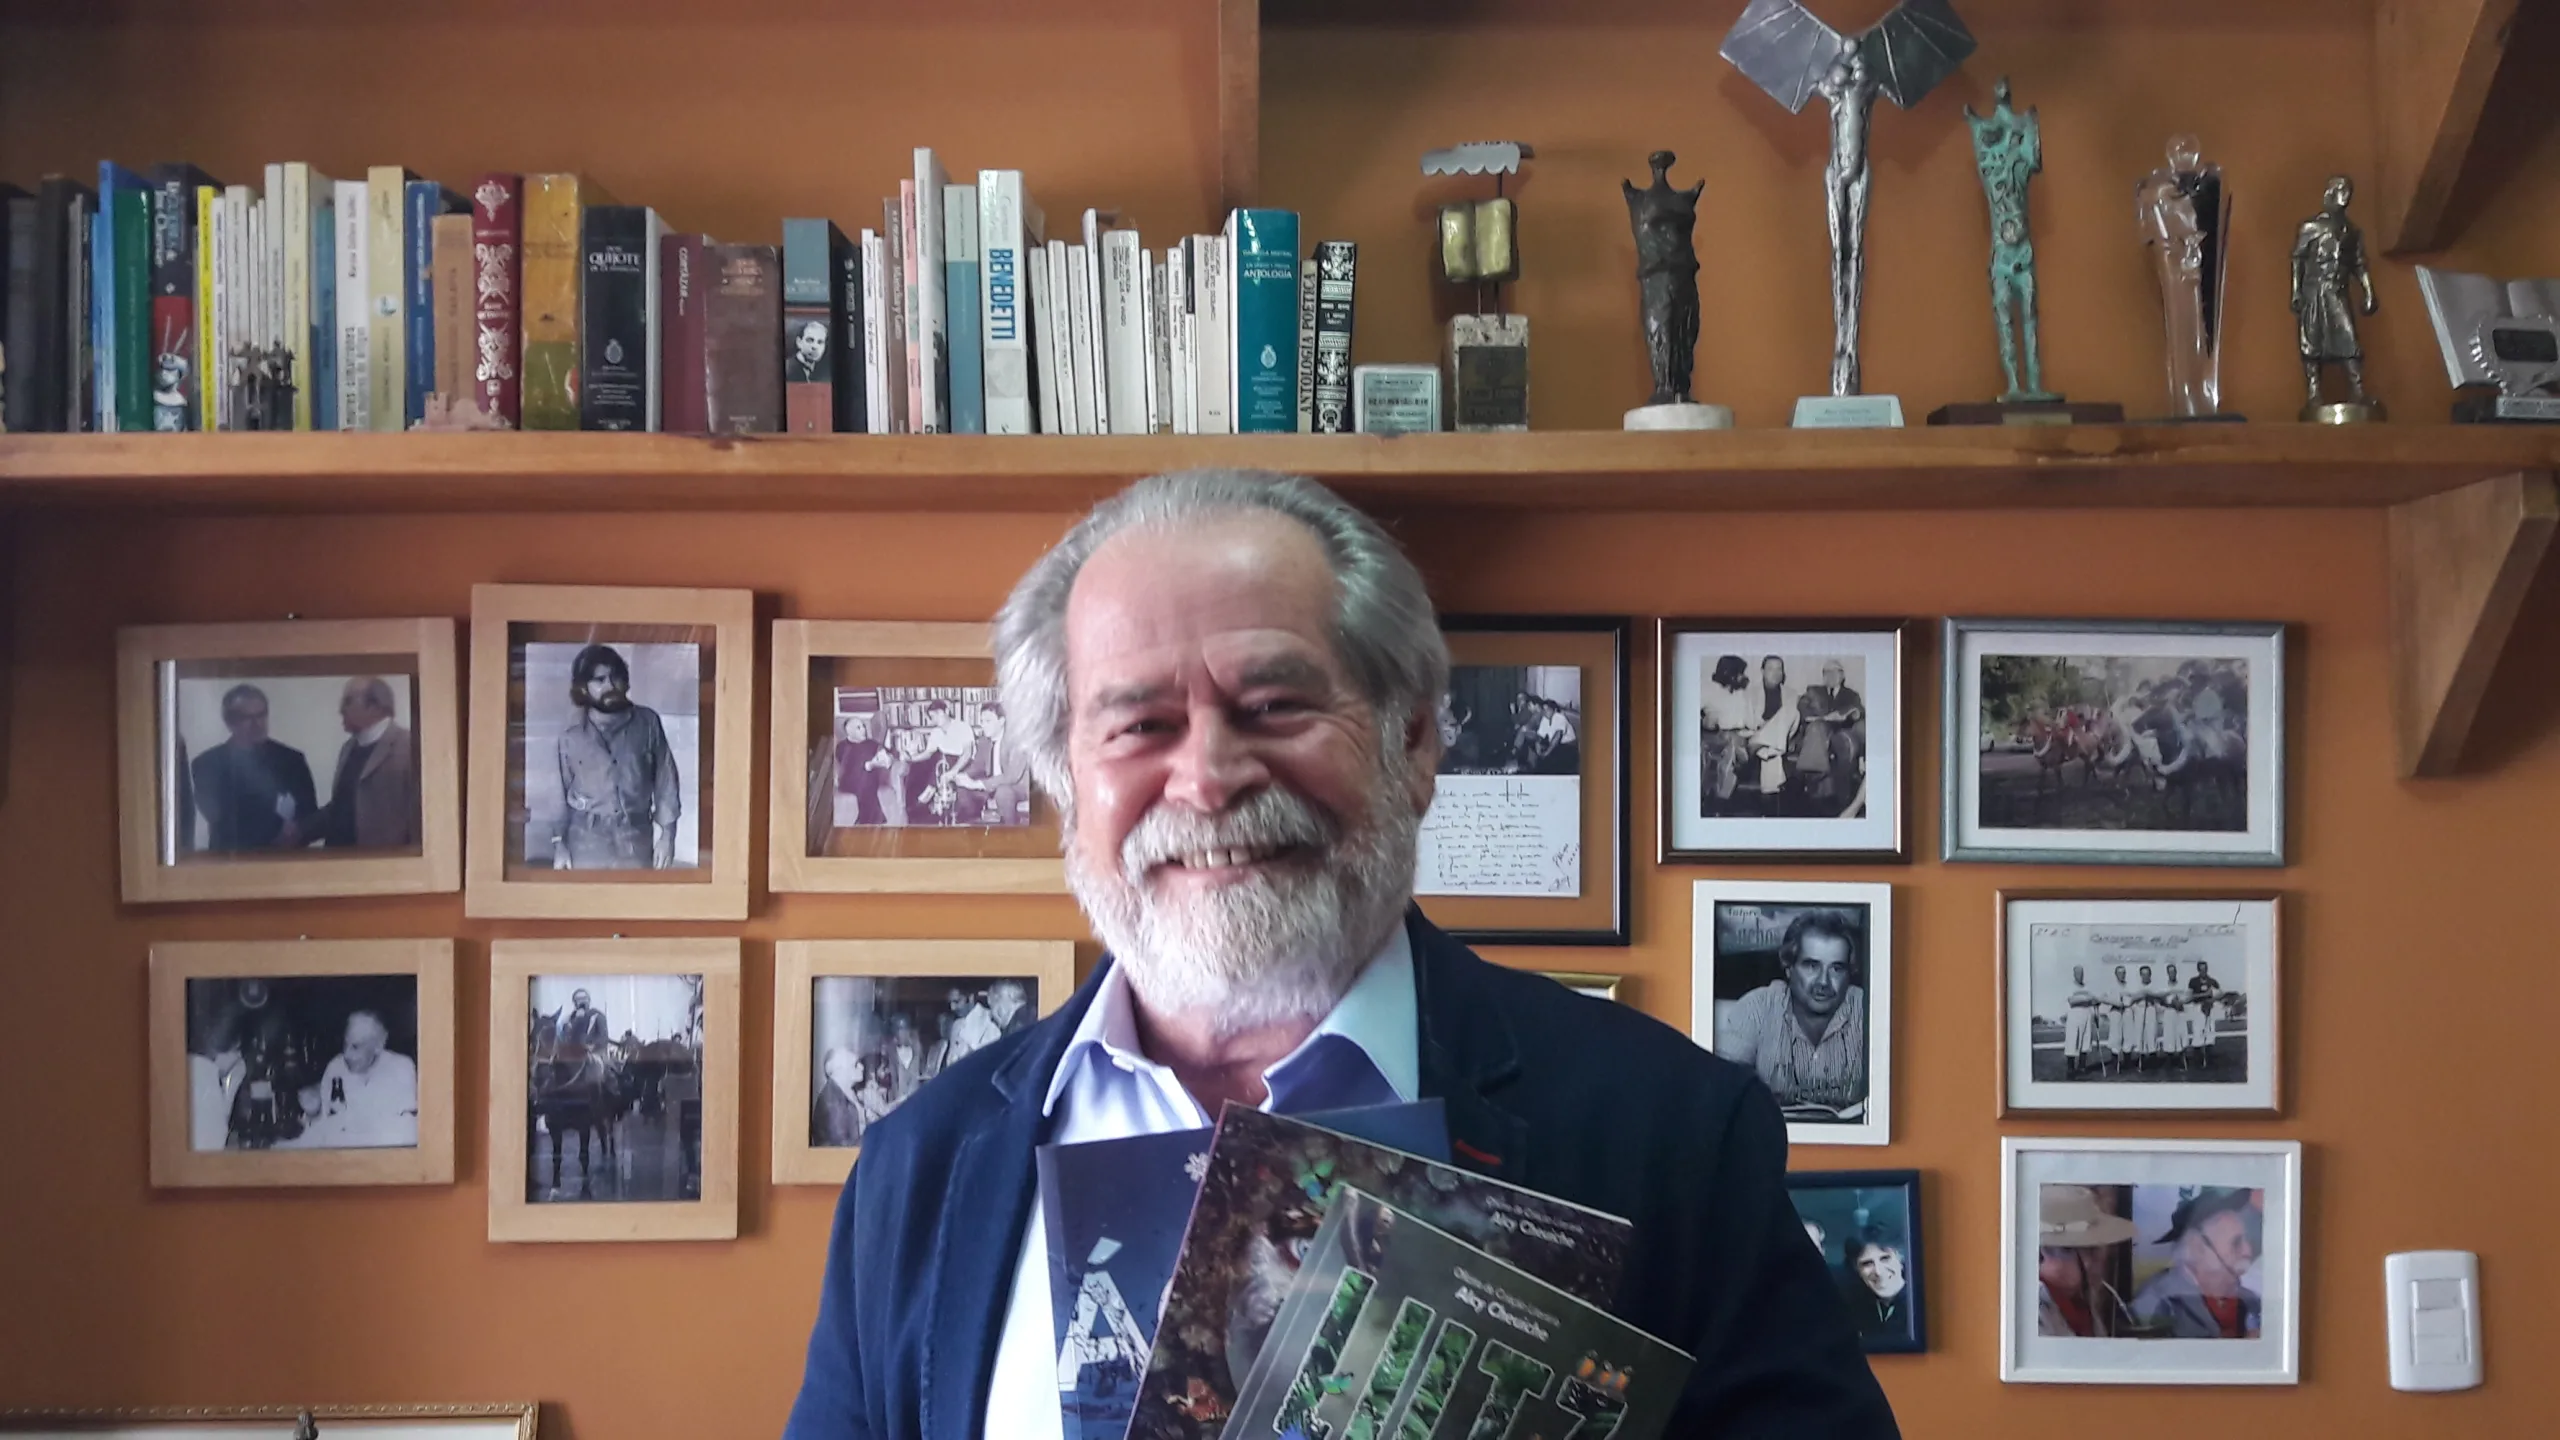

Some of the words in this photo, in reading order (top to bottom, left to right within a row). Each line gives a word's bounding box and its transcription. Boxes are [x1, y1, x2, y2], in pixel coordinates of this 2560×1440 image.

[989, 248, 1016, 340] BENEDETTI
[1455, 1285, 1487, 1314] Alcy
[1487, 1300, 1550, 1342] Cheuiche
